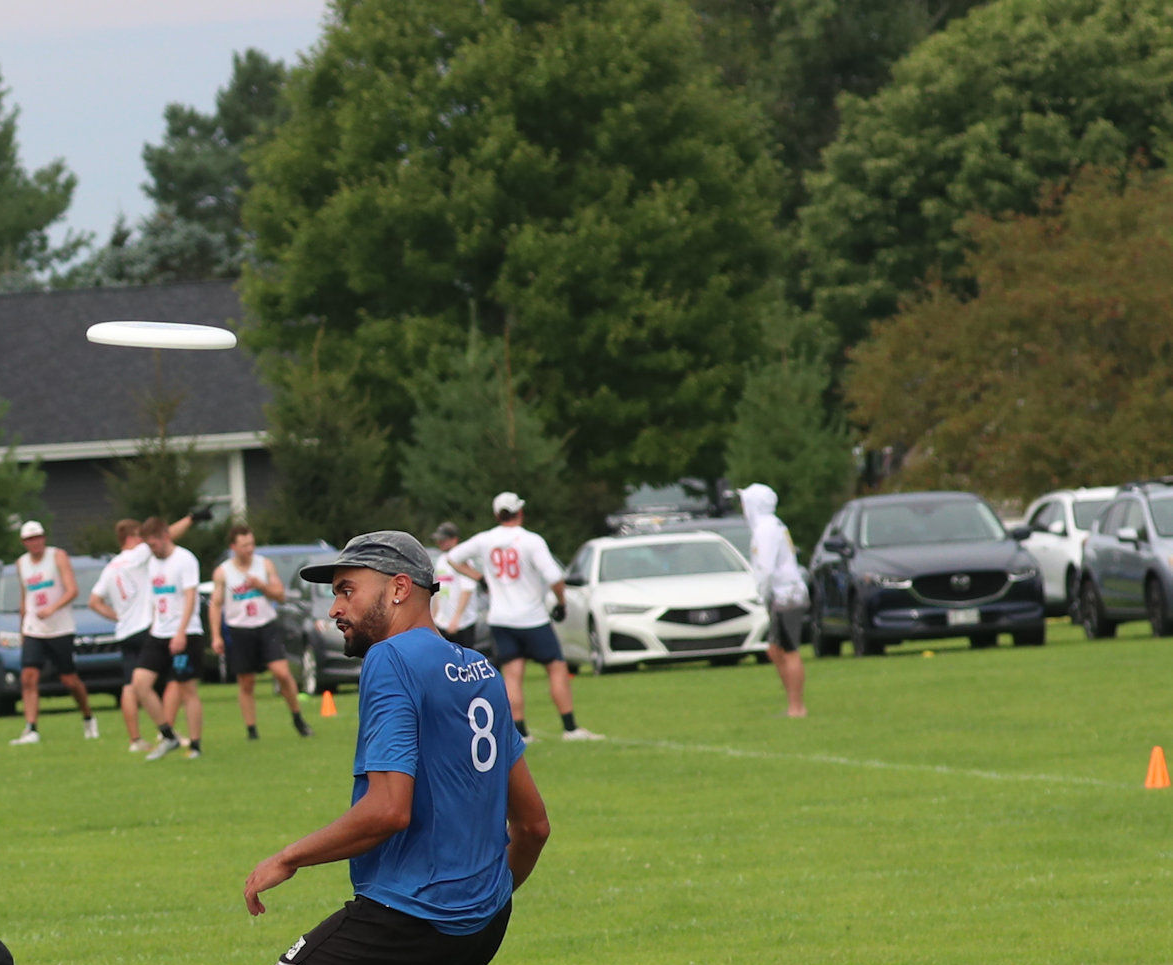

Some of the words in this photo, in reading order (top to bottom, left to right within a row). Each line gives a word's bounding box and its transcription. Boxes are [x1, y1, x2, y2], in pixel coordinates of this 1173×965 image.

[490, 547, 521, 580] 98
[444, 658, 496, 683] COATES
[467, 697, 498, 773] 8
